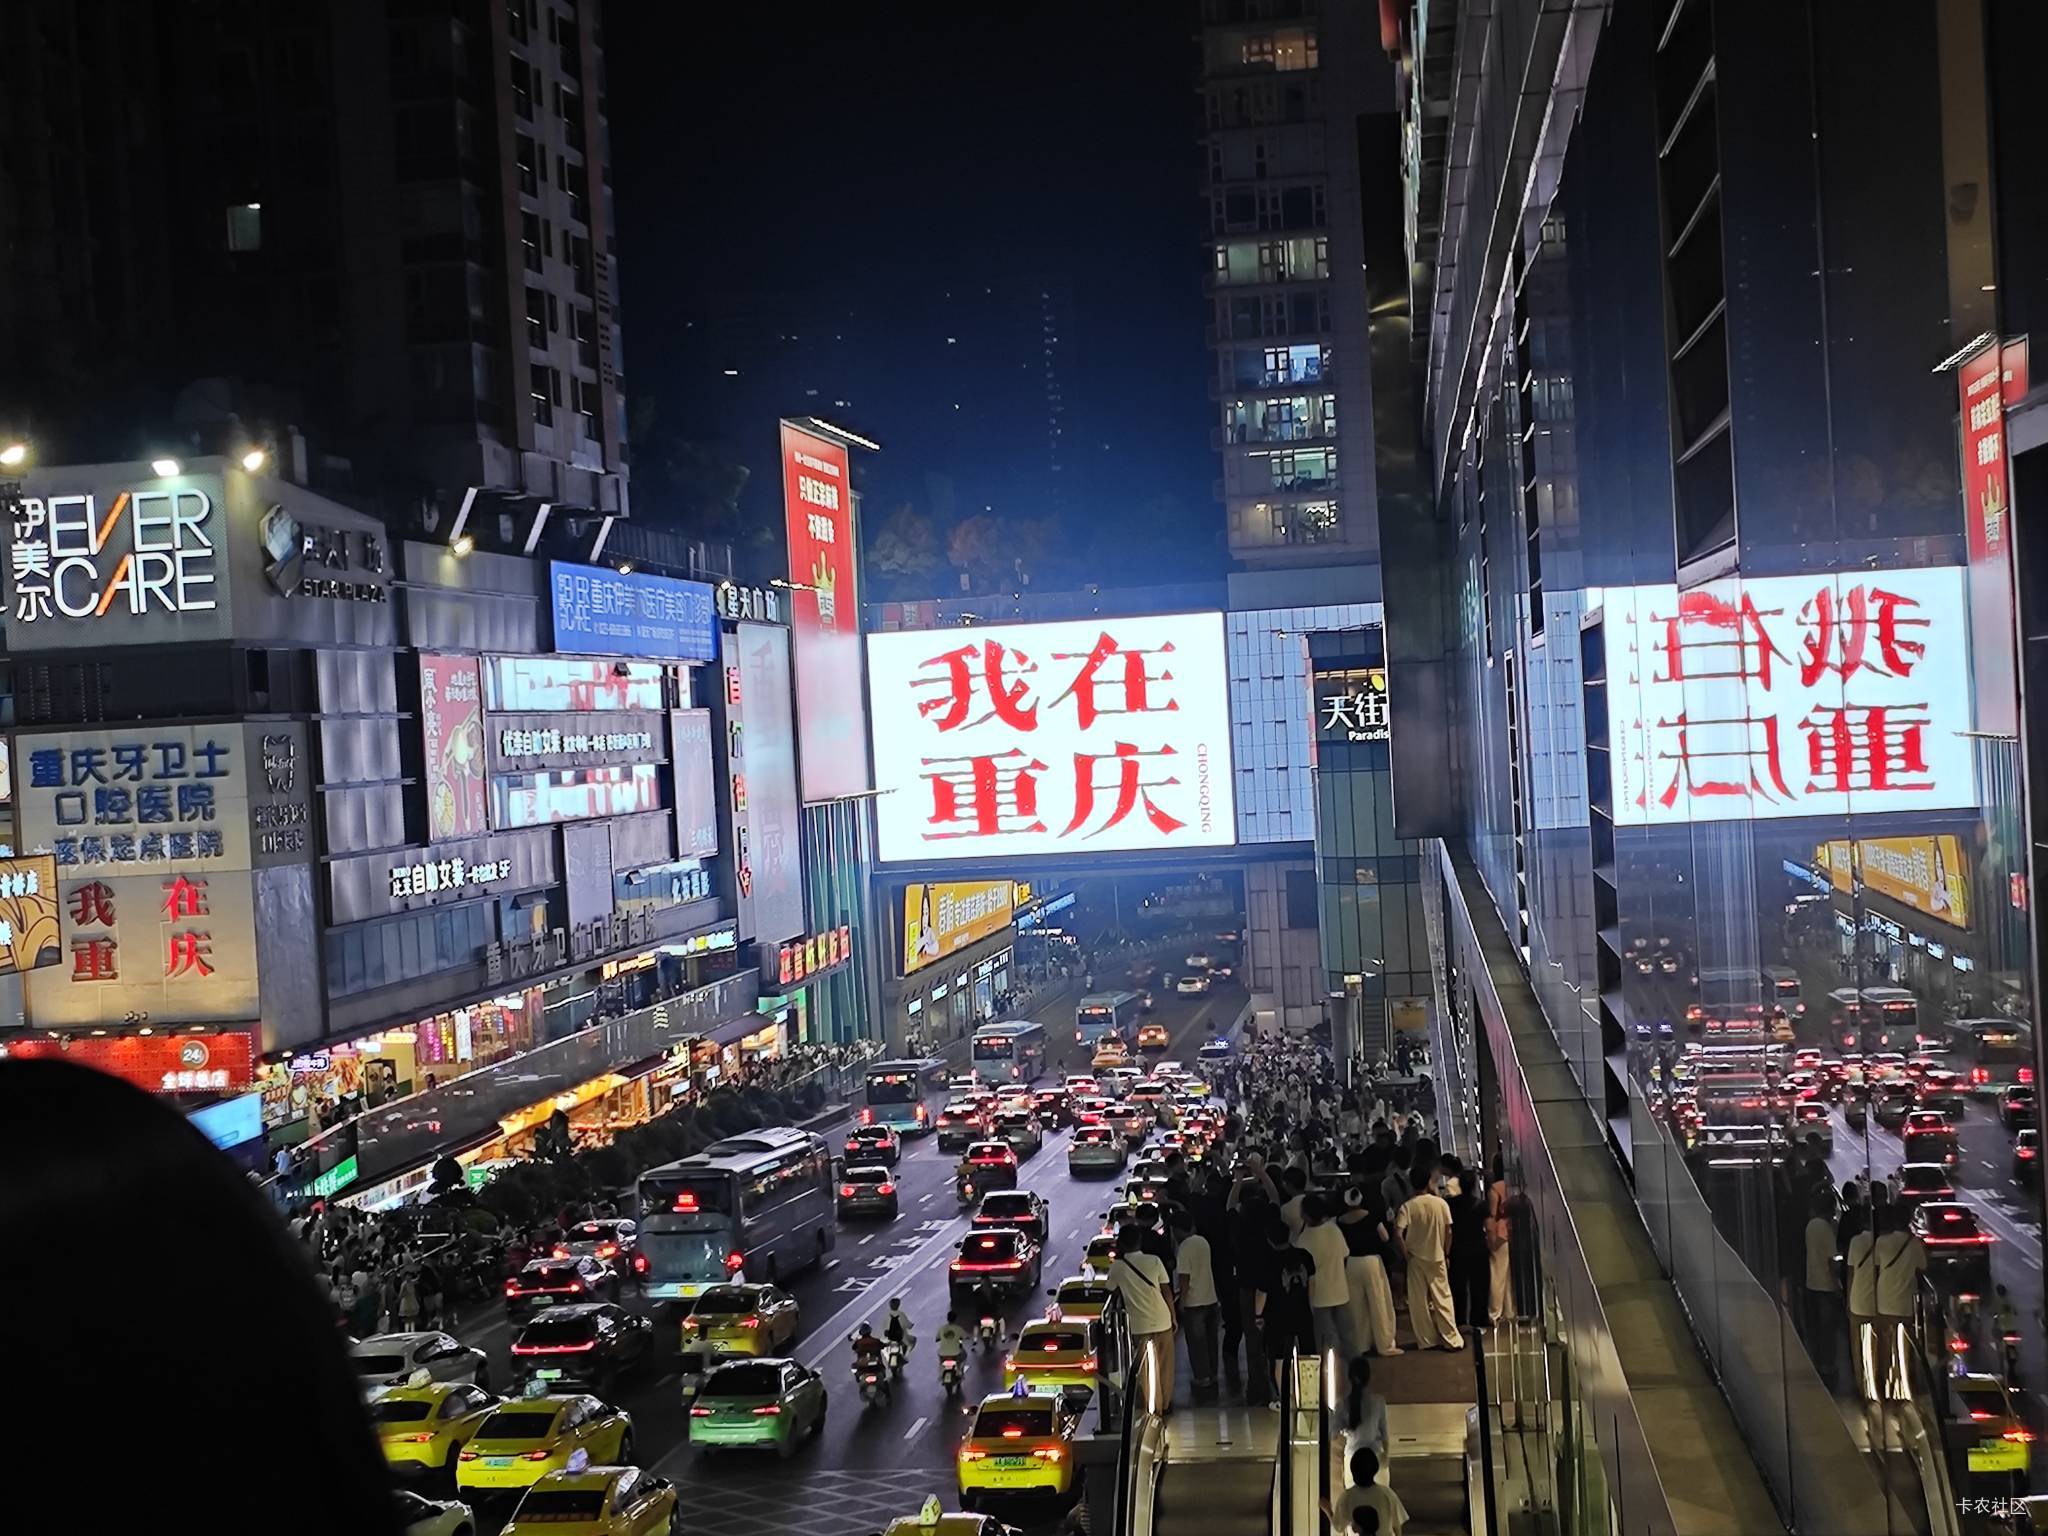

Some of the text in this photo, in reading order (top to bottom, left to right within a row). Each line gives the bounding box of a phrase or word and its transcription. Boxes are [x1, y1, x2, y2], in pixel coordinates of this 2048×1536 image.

[47, 489, 213, 558] EVER
[11, 498, 54, 622] 伊美尔
[54, 547, 216, 617] CARE
[303, 579, 386, 602] STAR PLAZA
[908, 632, 1180, 733] 我在
[1321, 692, 1389, 730] 天街
[29, 740, 231, 788] 重庆牙卫士
[919, 741, 1188, 841] 重庆
[1197, 743, 1213, 833] CHONGQING
[55, 783, 216, 826] 口腔医院
[67, 875, 211, 927] 我在
[71, 930, 214, 982] 重庆
